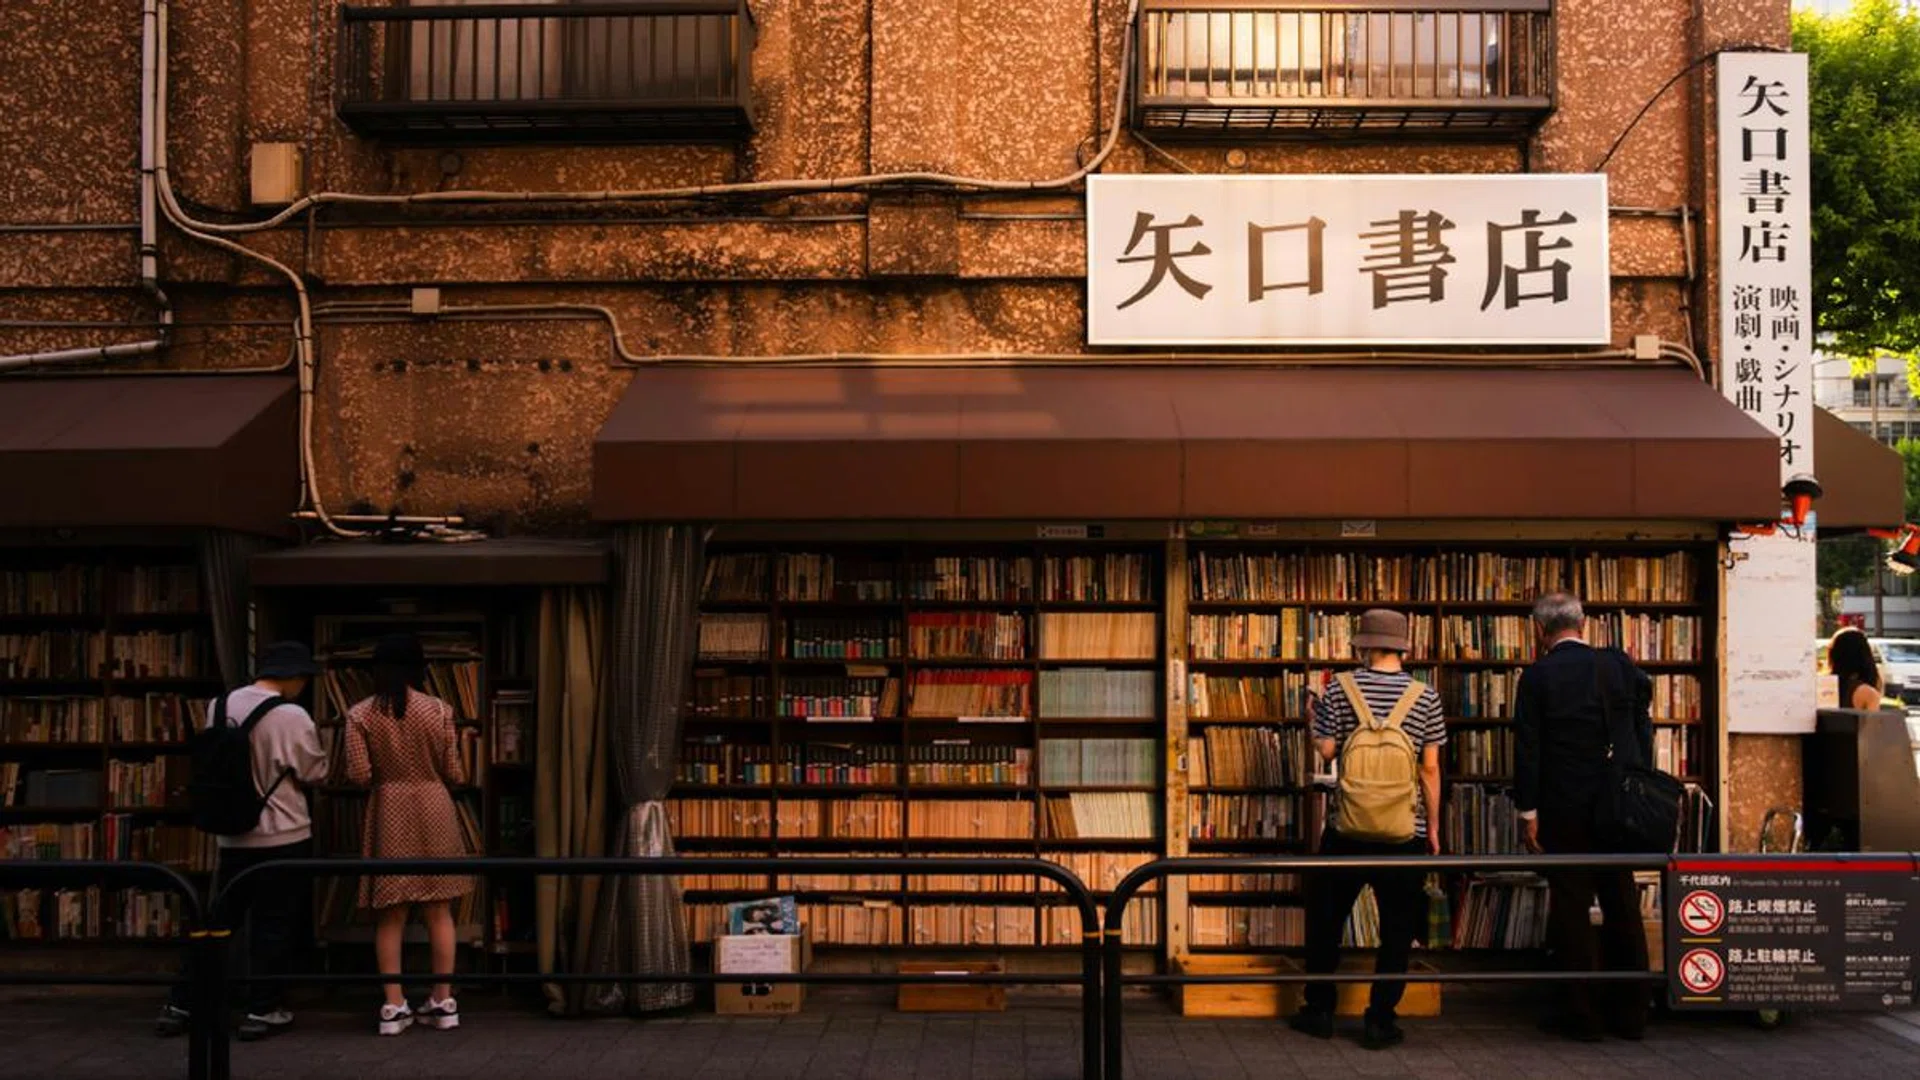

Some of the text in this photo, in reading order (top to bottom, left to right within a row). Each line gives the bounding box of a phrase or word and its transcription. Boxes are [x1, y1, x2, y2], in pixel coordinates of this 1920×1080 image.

[1738, 75, 1790, 264] 矢口書店
[1116, 209, 1576, 311] 矢口書店
[1732, 285, 1762, 413] 演劇・戯曲
[1770, 285, 1801, 466] 映画・シナリオ
[1679, 874, 1731, 887] 千代田区内
[1728, 899, 1817, 914] 路上喫煙禁止
[1728, 948, 1816, 963] 路上駐輪禁止
